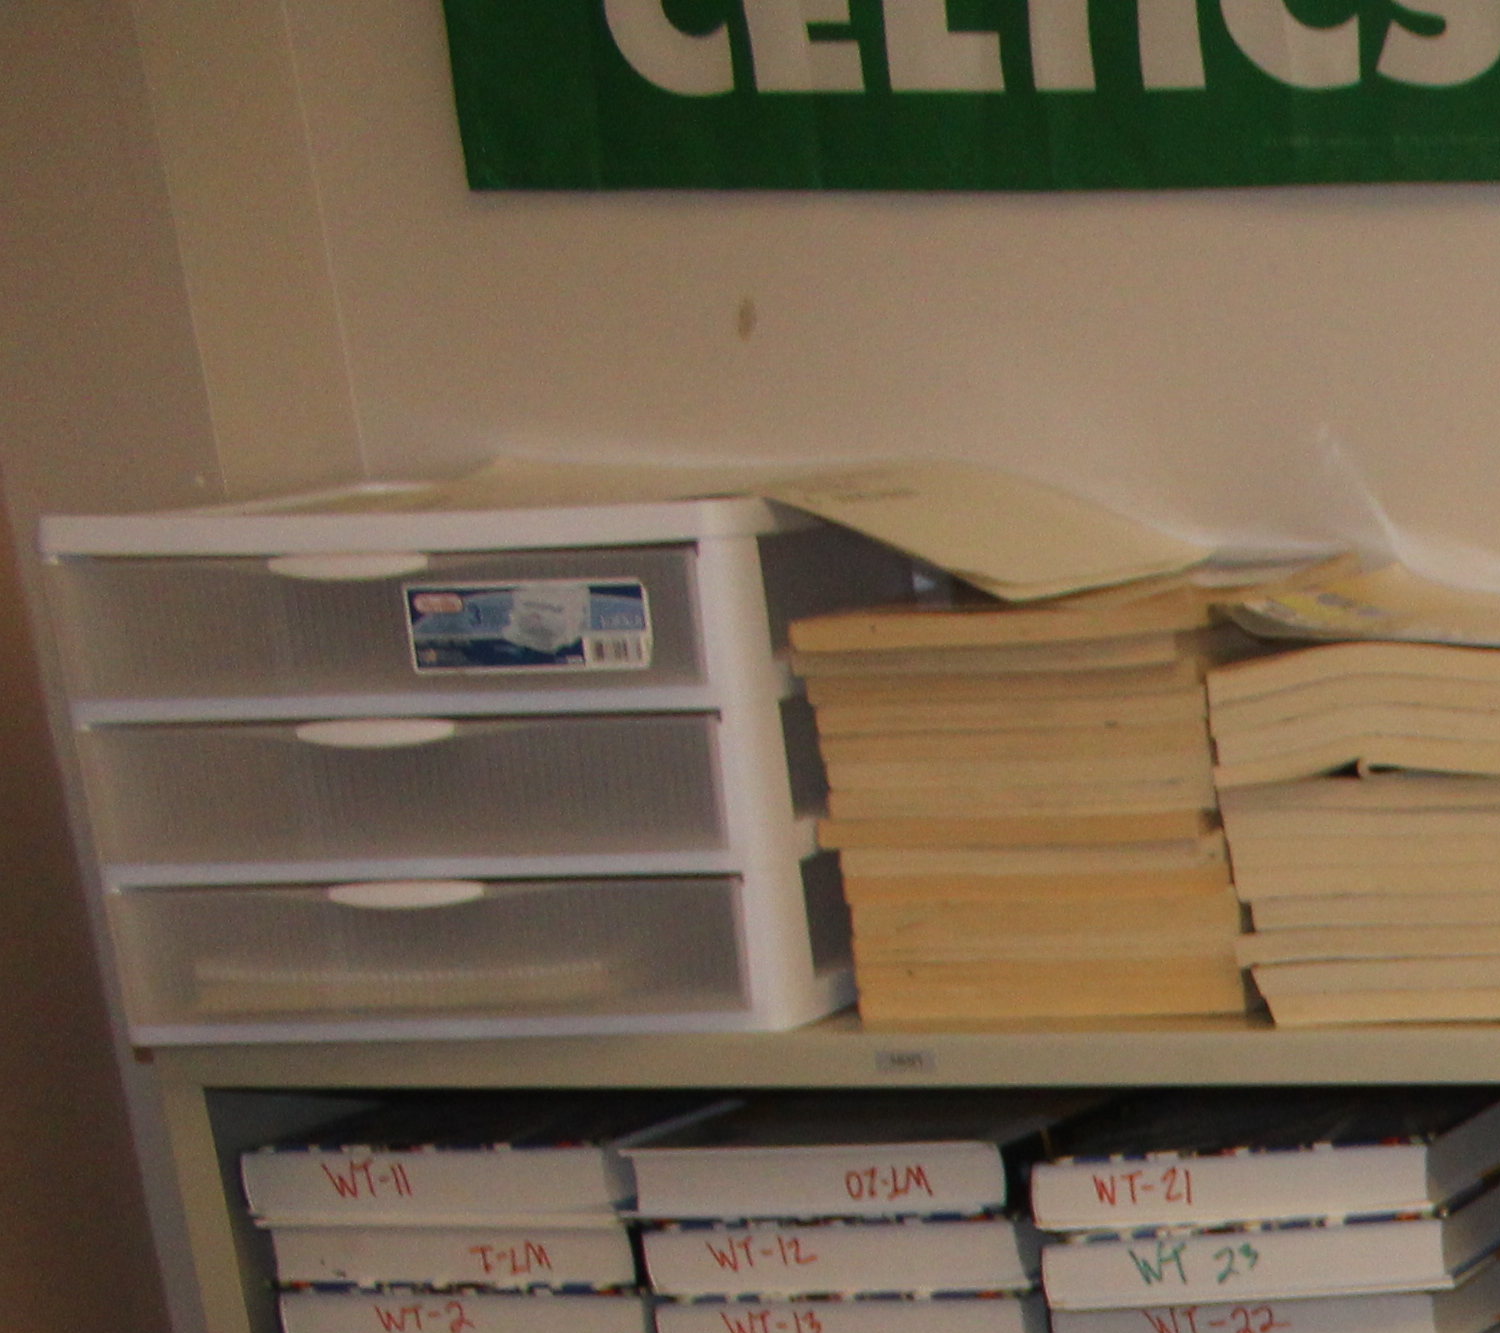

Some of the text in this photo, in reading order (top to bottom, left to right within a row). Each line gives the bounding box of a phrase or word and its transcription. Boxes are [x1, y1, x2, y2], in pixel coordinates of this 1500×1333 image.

[319, 1159, 412, 1198] WT-11
[1089, 1163, 1192, 1206] WT-21
[703, 1234, 818, 1272] WT-12
